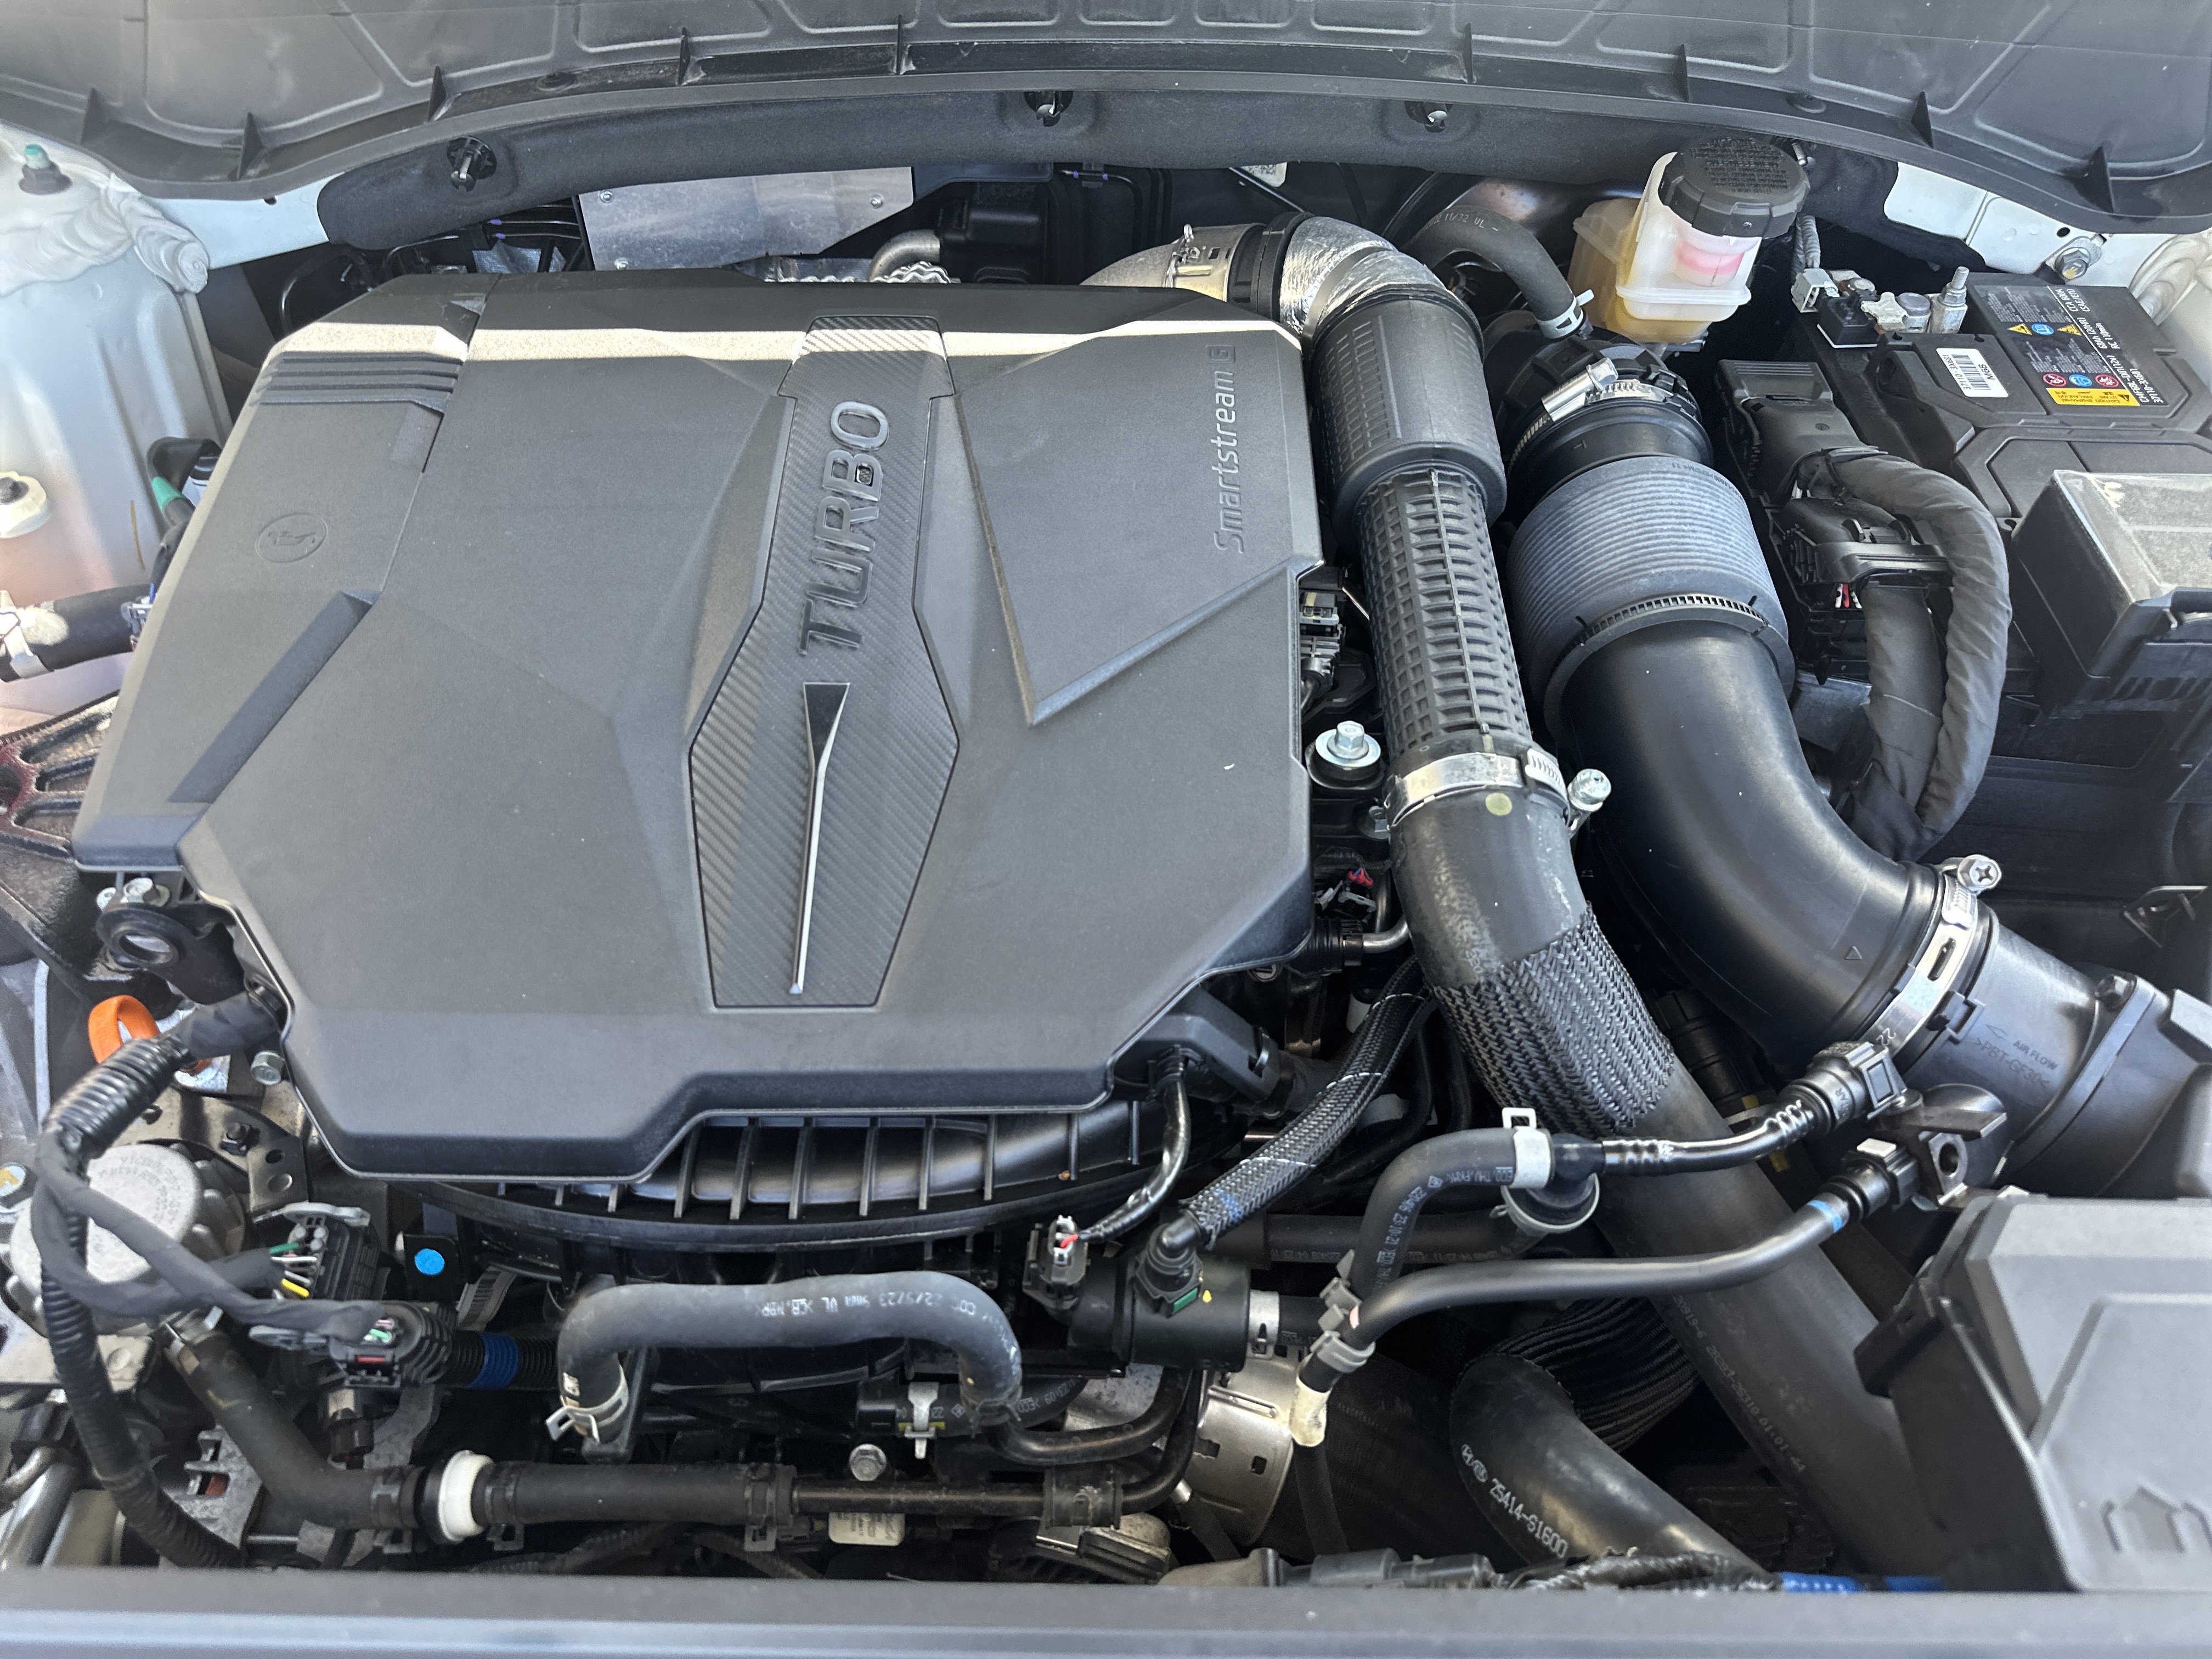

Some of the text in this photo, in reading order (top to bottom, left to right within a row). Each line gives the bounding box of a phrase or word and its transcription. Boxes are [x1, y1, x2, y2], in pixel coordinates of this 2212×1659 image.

[2066, 302, 2078, 312] CCA
[1978, 364, 1996, 380] M68
[1211, 372, 1245, 554] Smartstream
[798, 400, 890, 656] TURBO
[2012, 1040, 2058, 1071] AIR FLOW
